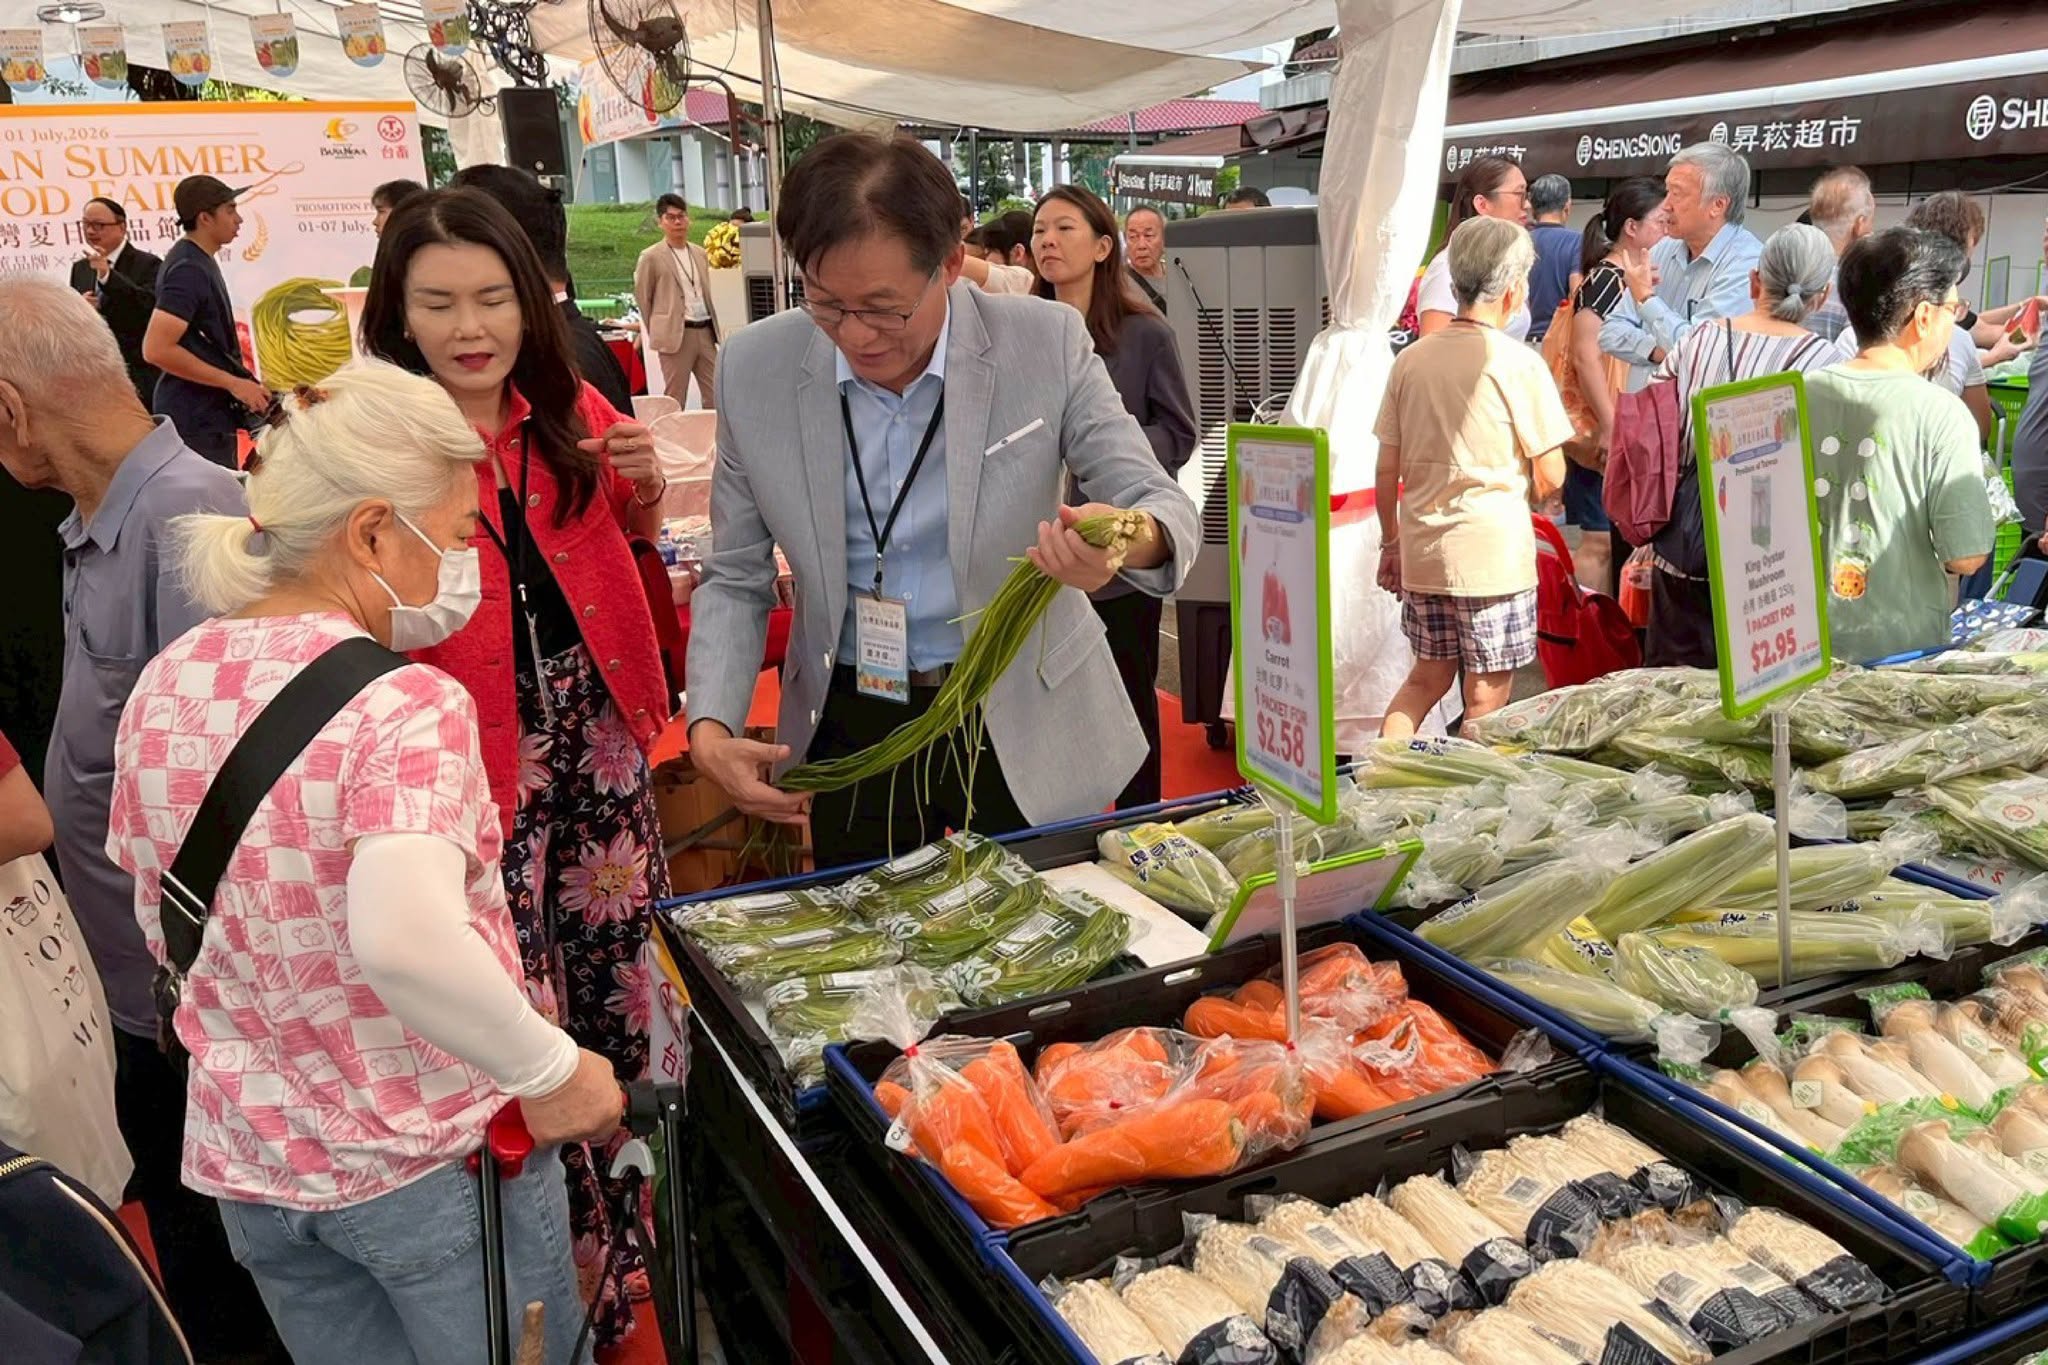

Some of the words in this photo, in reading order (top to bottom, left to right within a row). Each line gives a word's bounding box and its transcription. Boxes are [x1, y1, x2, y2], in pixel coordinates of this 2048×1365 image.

[1593, 133, 1681, 160] SHENGSIONG
[1731, 115, 1862, 152] 昇菘超市
[64, 143, 272, 178] SUMMER
[295, 202, 360, 213] PROMOTION
[298, 220, 337, 233] 01-07
[1265, 648, 1290, 670] Carrot
[1750, 627, 1798, 675] $2.95
[1261, 692, 1289, 719] PACKET
[1256, 709, 1305, 769] $2.58
